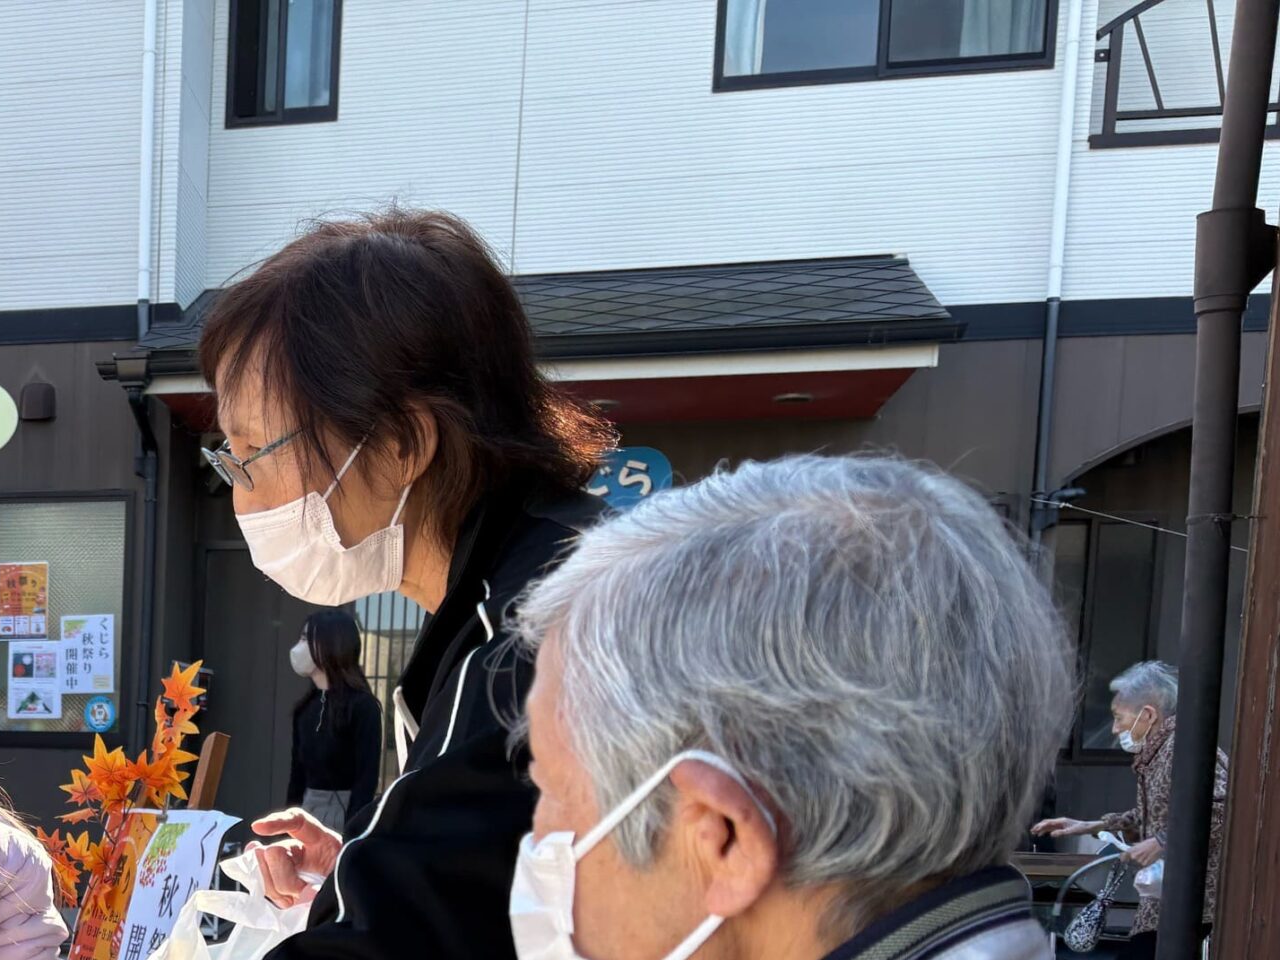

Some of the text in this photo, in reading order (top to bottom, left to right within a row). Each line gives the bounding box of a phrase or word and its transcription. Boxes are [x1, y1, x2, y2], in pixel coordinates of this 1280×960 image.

[82, 632, 94, 674] 秋祭り
[99, 617, 110, 660] くじら
[65, 648, 78, 690] 開催中
